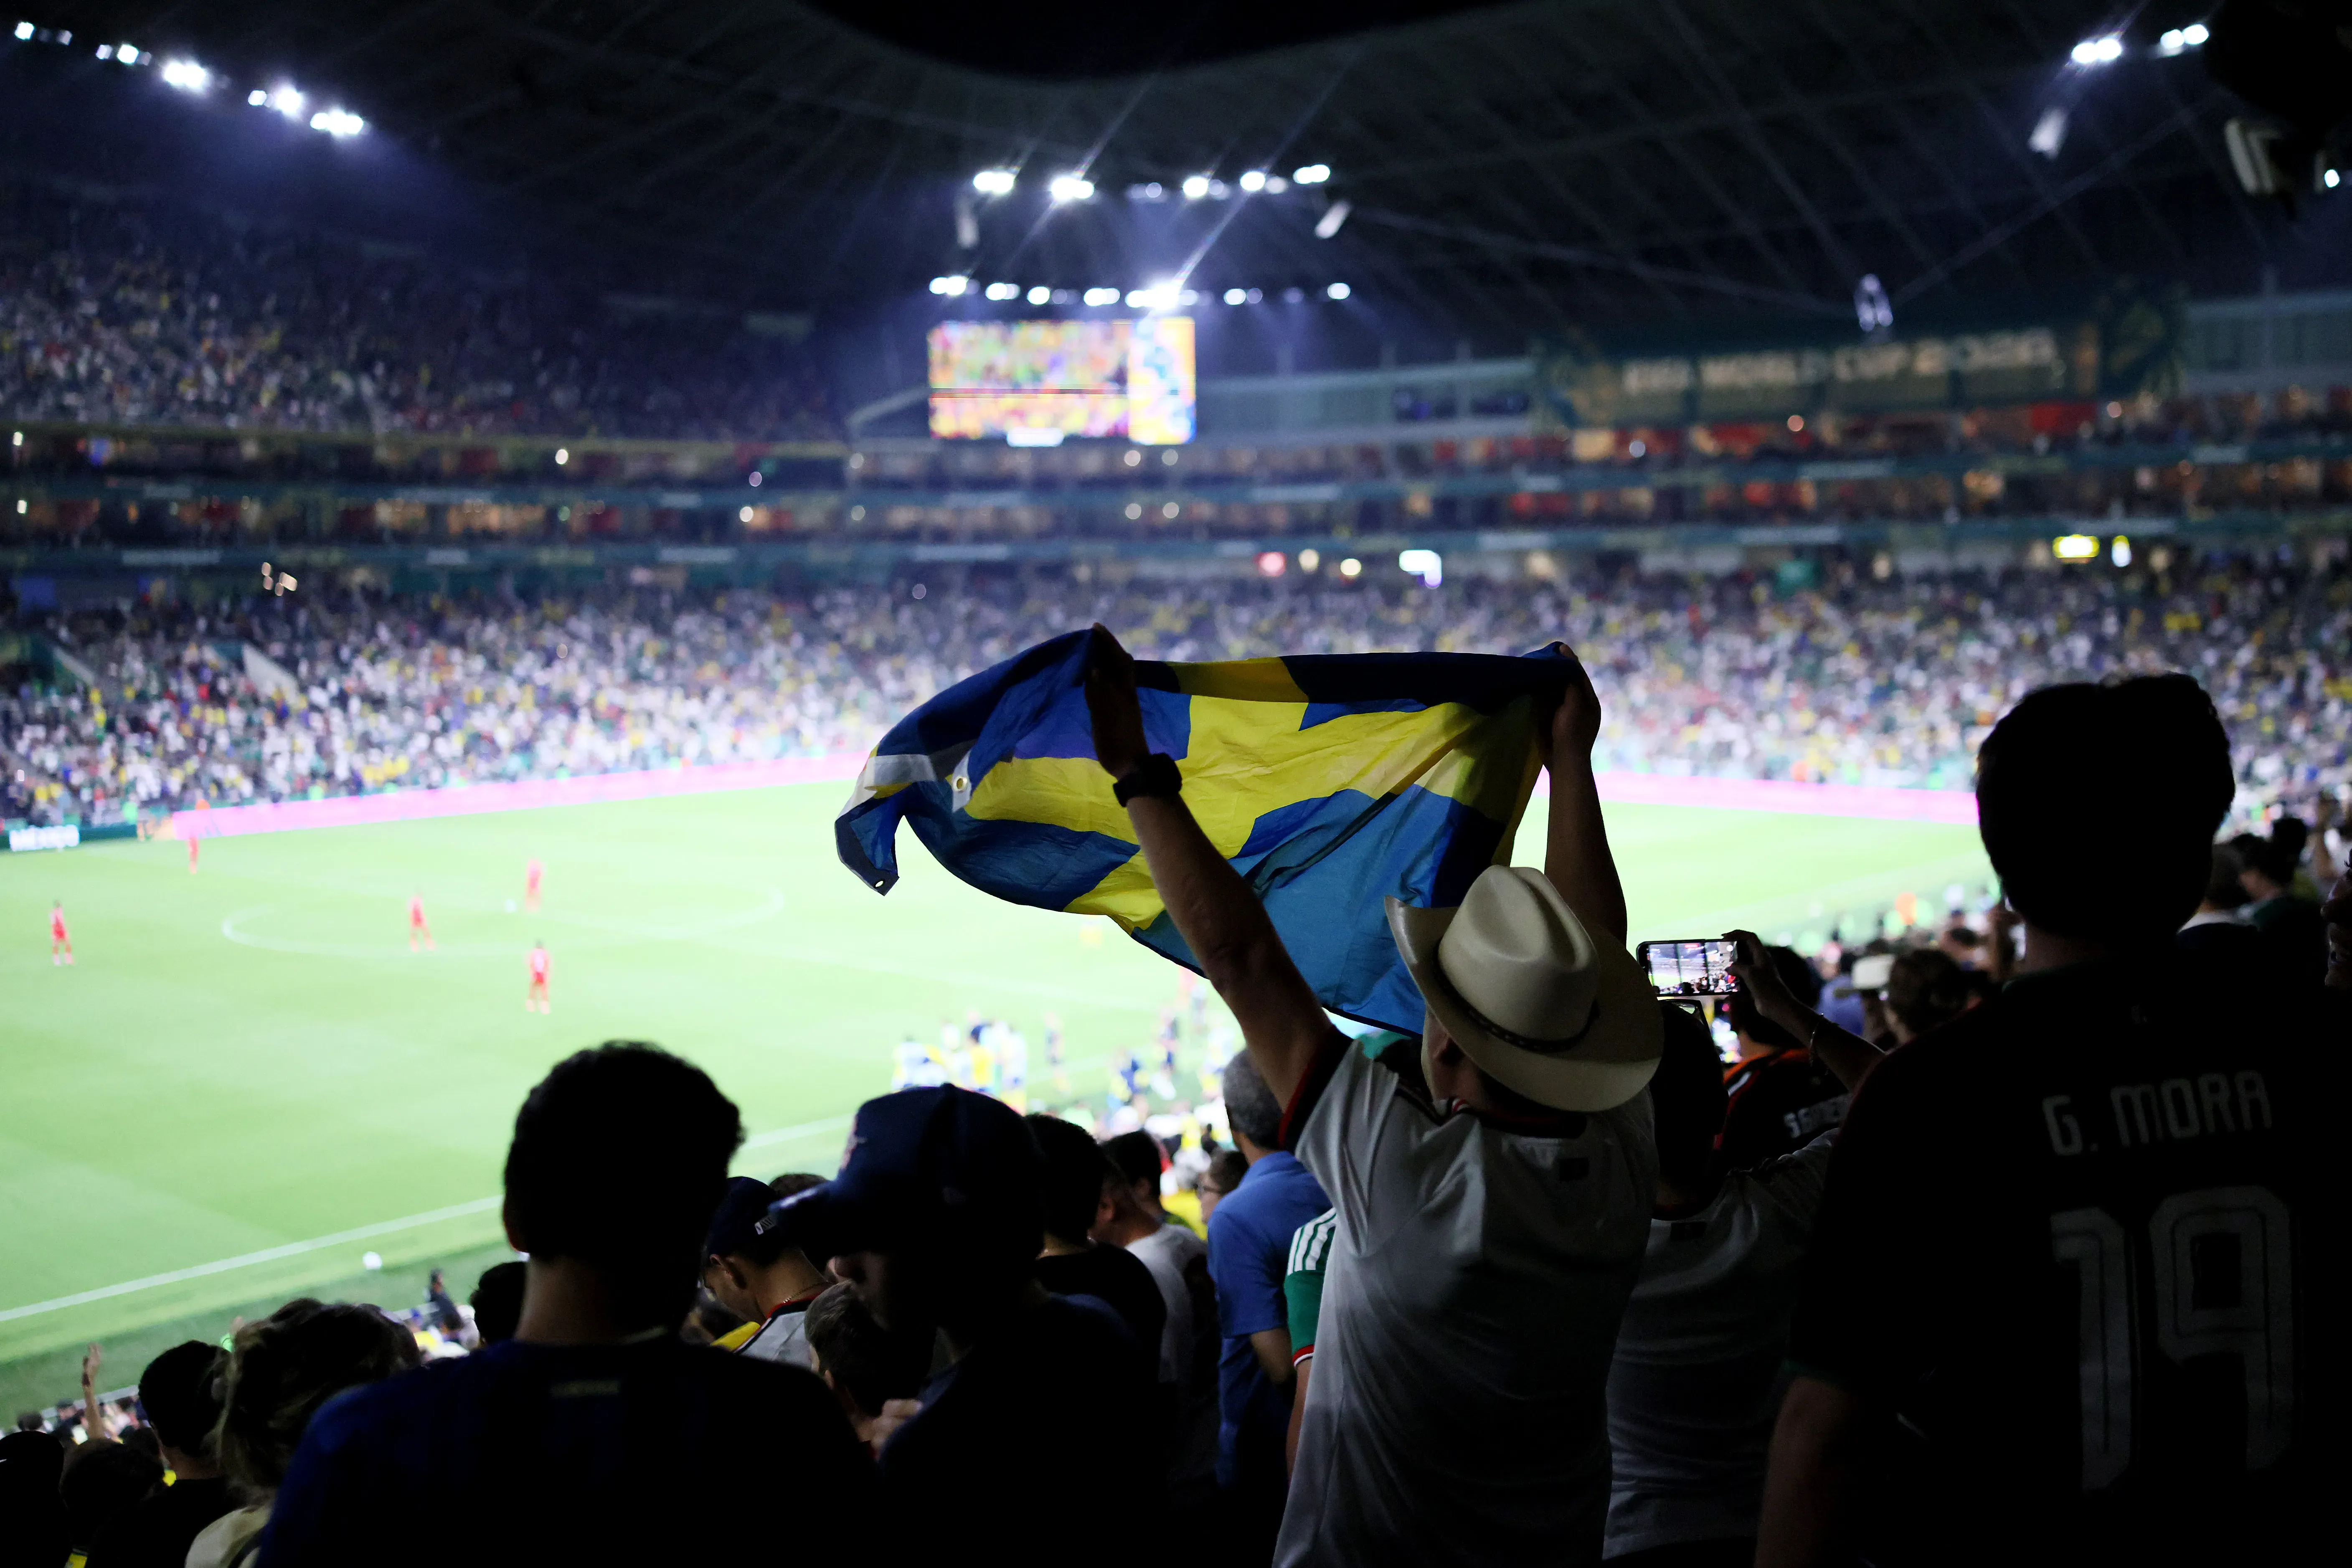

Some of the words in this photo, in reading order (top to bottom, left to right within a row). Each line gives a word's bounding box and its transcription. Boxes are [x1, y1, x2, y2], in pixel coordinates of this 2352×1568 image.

[1699, 348, 1825, 388] WORLD
[1835, 342, 1909, 380] CUP
[1913, 328, 2056, 375] 2026
[2042, 1094, 2098, 1156] G.
[2110, 1069, 2273, 1148] MORA
[2049, 1185, 2296, 1497] 19
